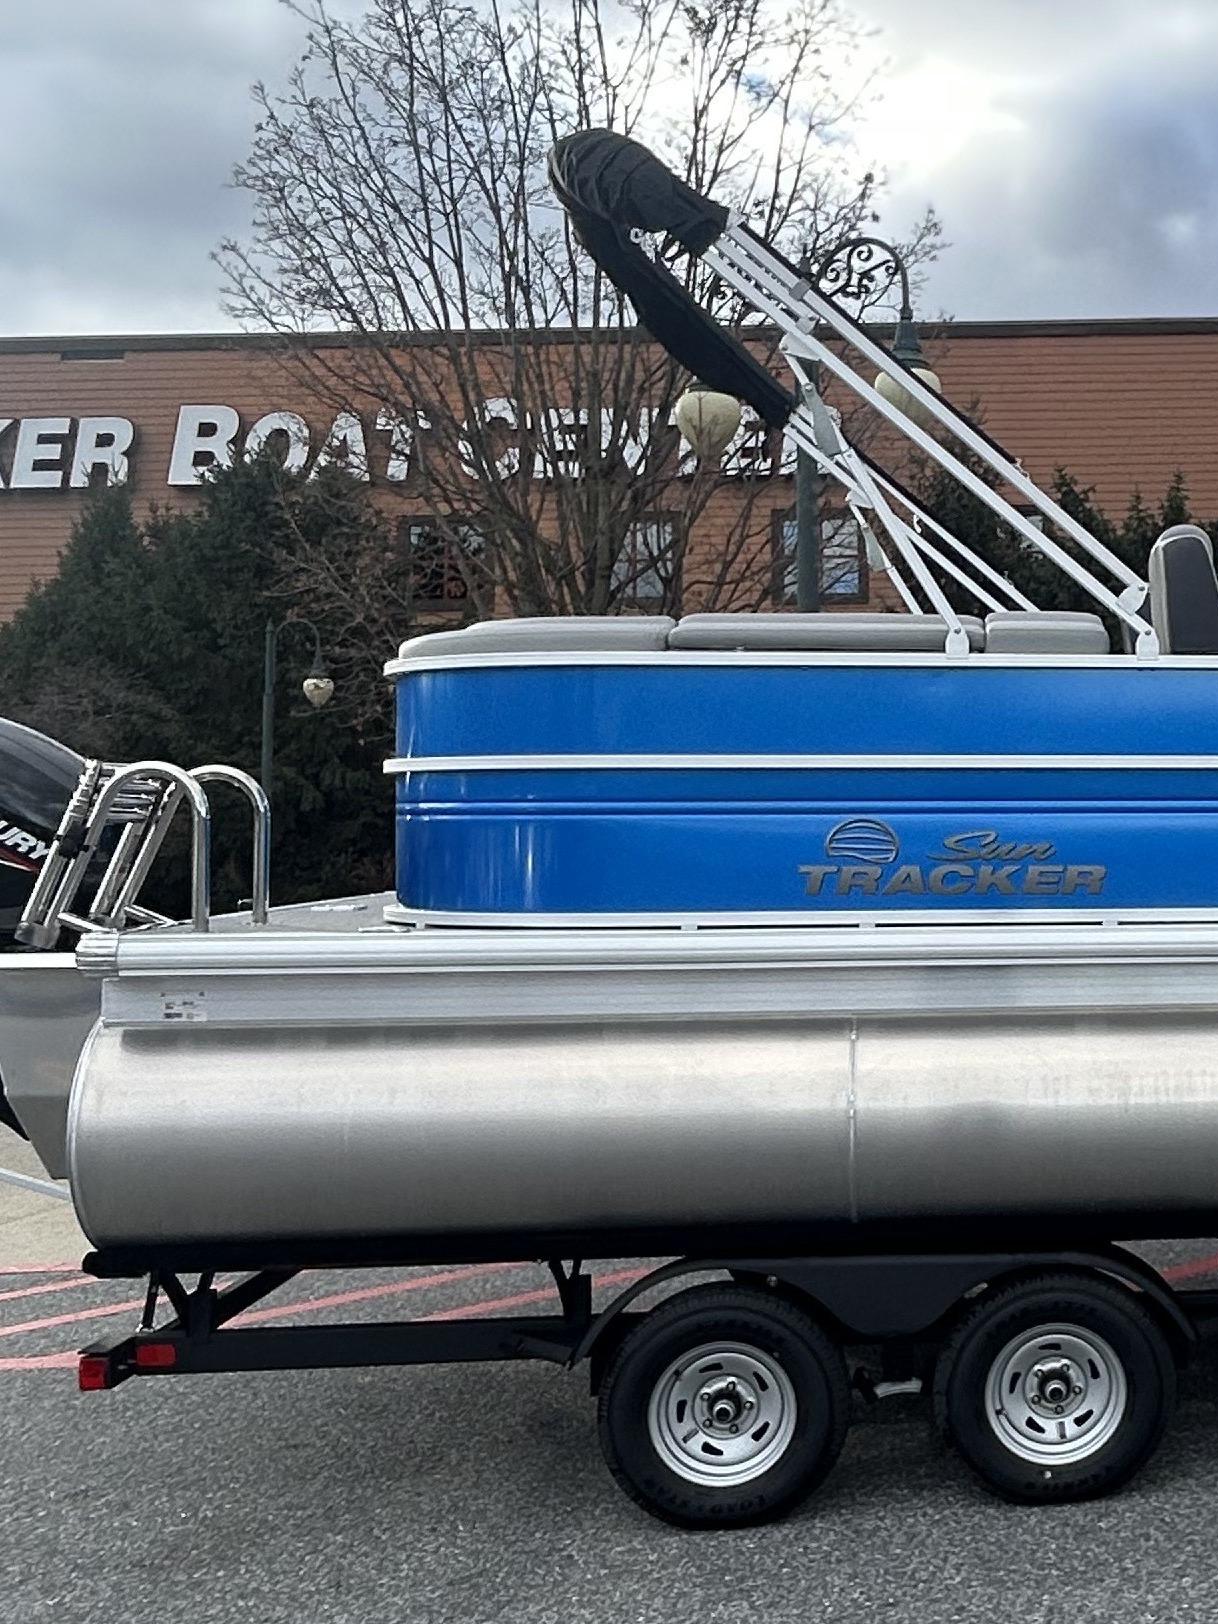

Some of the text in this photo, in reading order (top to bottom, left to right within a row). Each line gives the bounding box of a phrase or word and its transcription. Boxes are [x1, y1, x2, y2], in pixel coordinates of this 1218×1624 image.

[0, 415, 135, 490] ER
[926, 829, 1056, 862] Sun
[797, 864, 1107, 896] TRACKER
